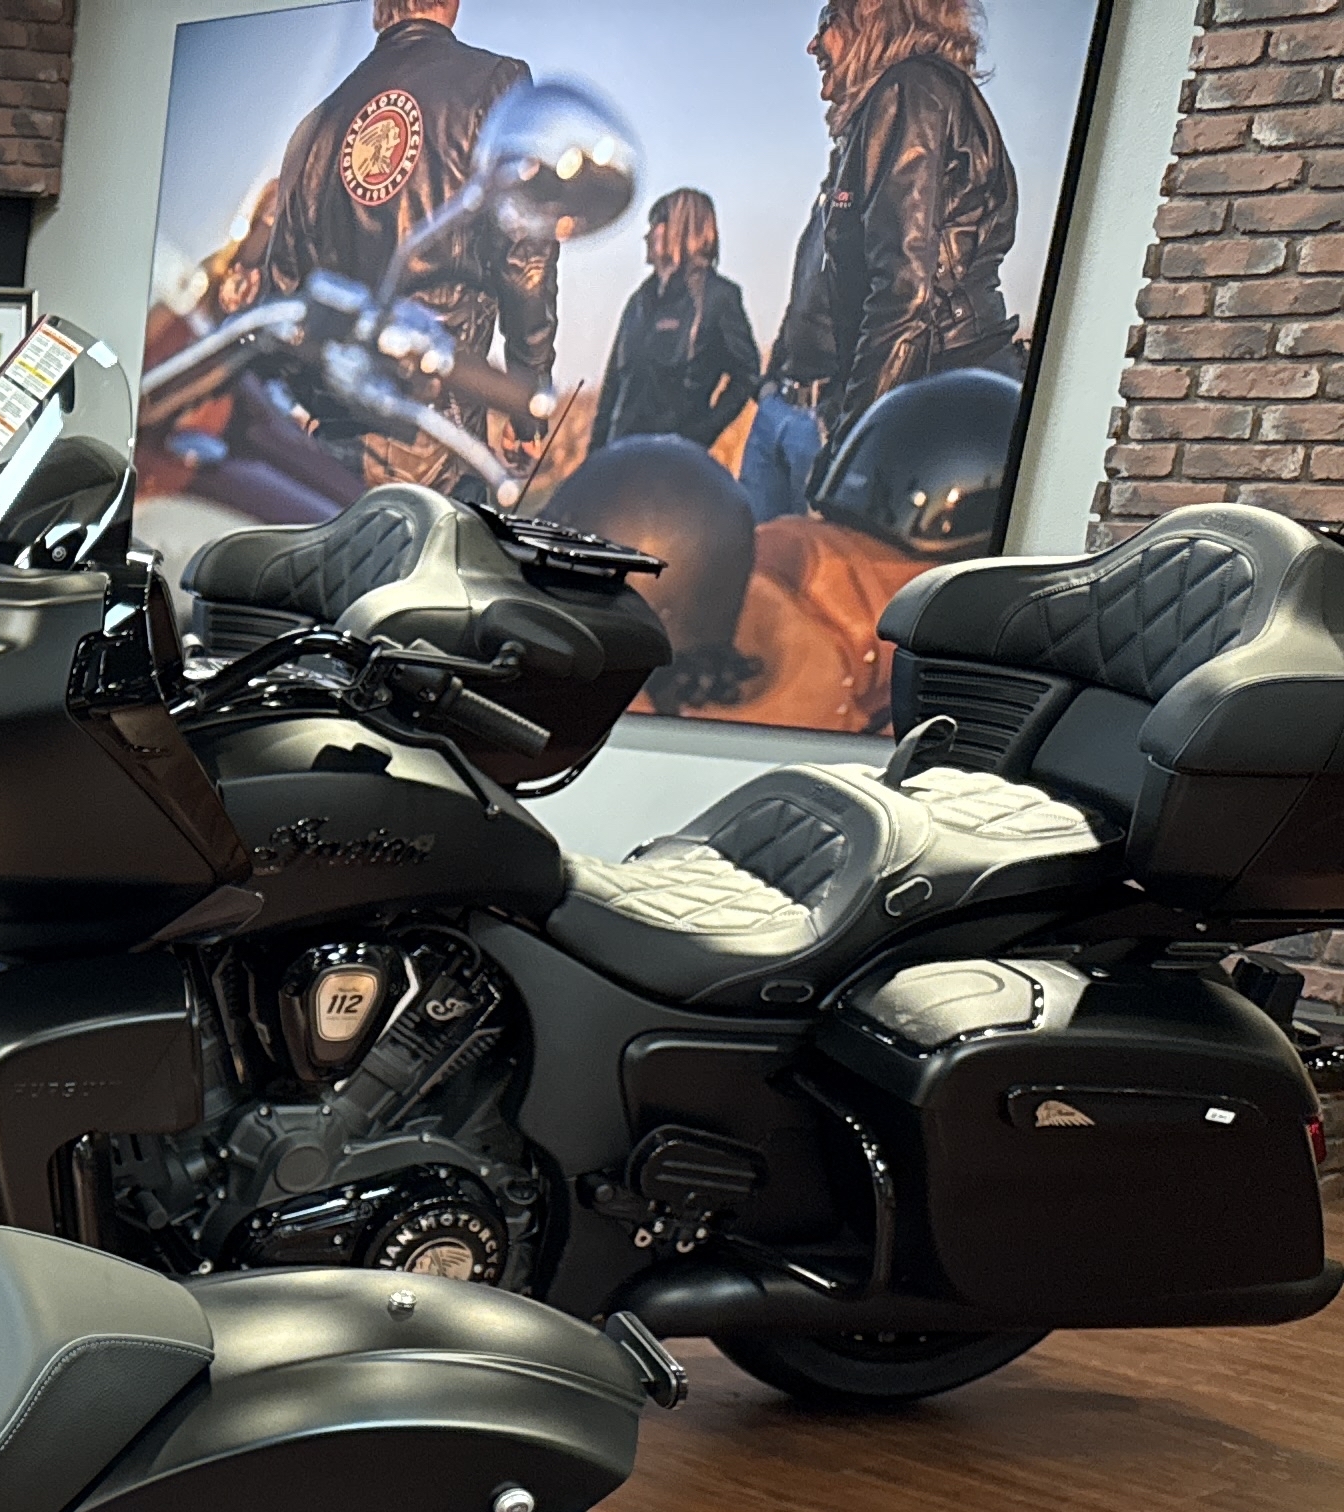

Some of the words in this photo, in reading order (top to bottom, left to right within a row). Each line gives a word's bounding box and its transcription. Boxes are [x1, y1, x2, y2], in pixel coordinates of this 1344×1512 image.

[343, 116, 363, 189] INDIAN
[367, 92, 420, 171] MOTORCYCLE
[365, 184, 394, 201] 1901
[325, 993, 364, 1015] 112
